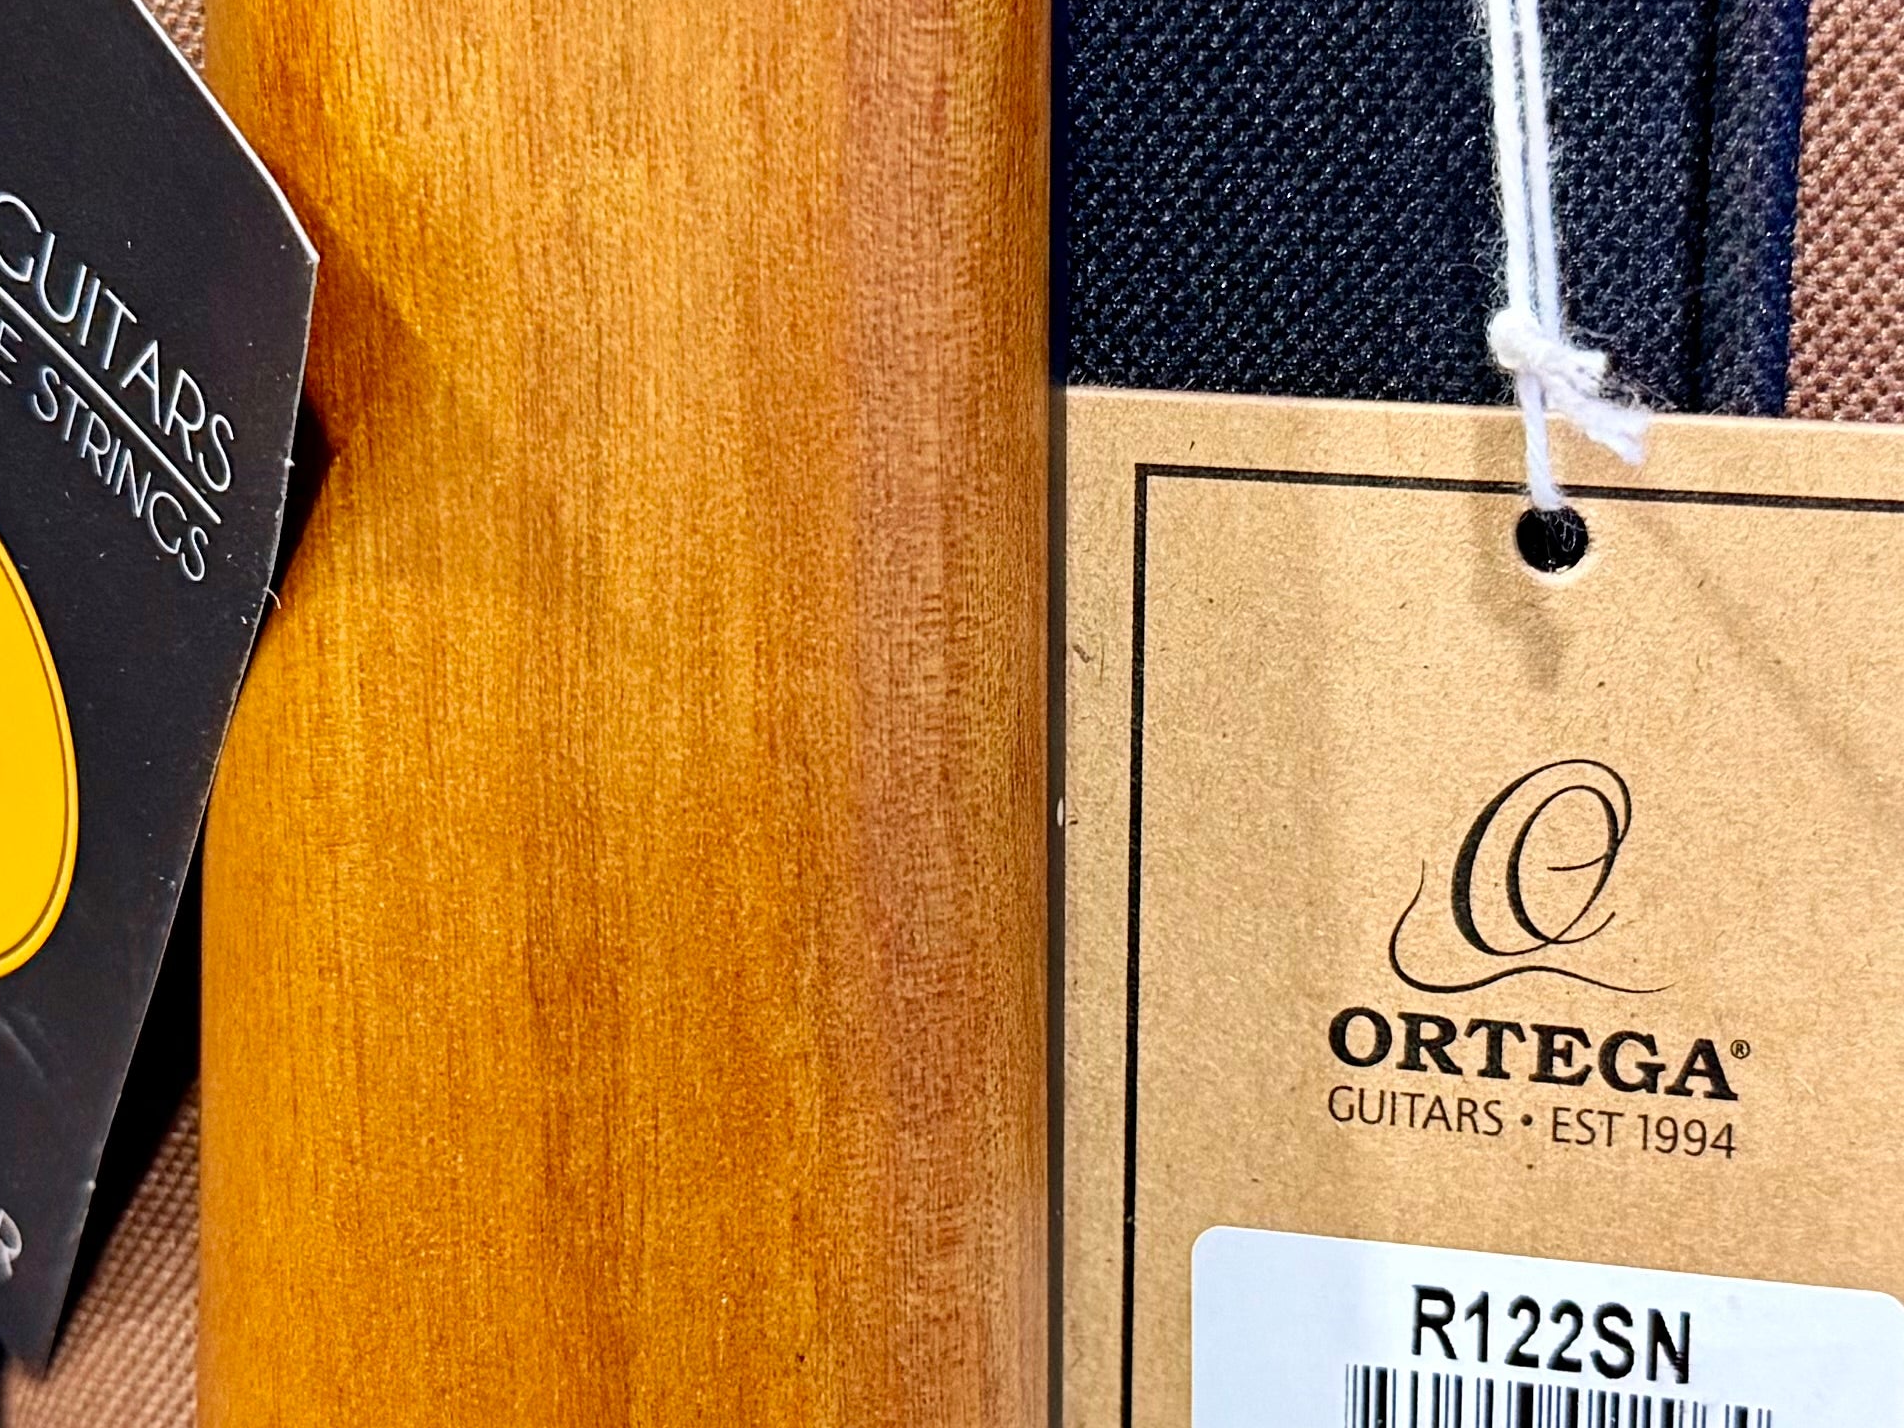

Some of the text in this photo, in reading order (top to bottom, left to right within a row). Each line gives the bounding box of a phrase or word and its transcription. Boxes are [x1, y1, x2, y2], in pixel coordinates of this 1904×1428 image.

[31, 366, 210, 583] STRINGS
[1328, 1085, 1738, 1160] GUITARS EST 1994
[1410, 1284, 1692, 1384] R122SN
